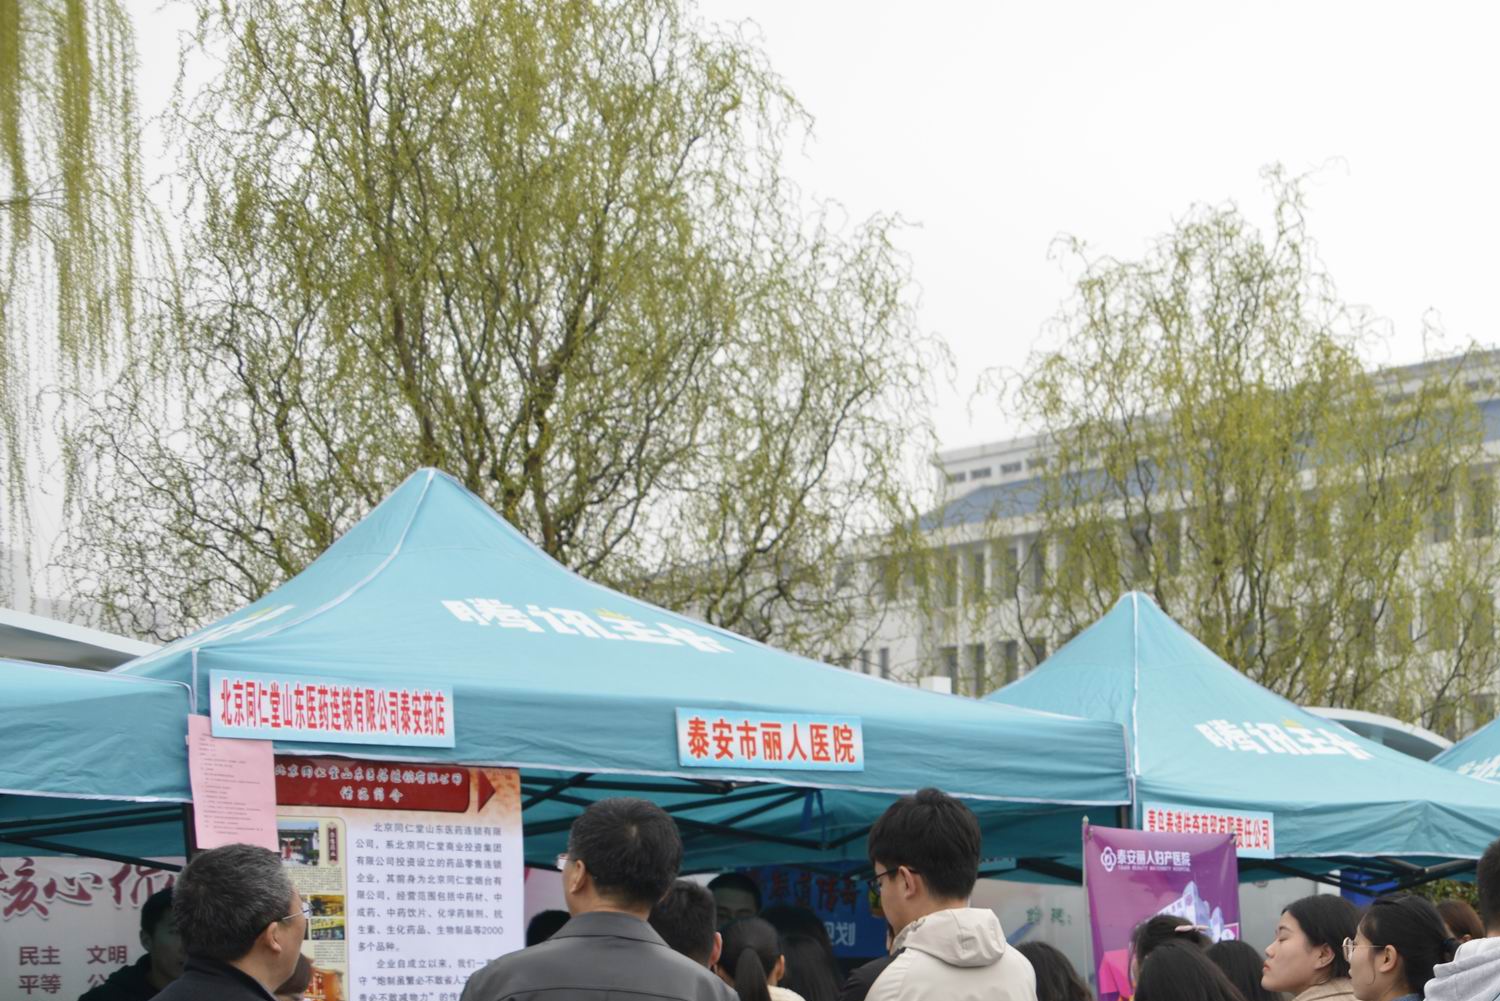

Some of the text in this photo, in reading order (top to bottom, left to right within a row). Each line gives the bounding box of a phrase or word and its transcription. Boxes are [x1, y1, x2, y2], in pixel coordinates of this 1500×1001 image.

[221, 679, 446, 736] 北京同仁堂山东医药连锁有限公司泰安药店
[687, 717, 855, 763] 泰安市丽人医院
[1117, 849, 1192, 867] 泰安丽人妇产医院
[0, 857, 178, 917] 核心价
[19, 946, 127, 966] 民主 文明
[376, 958, 495, 969] 企业自成立以来，我们一
[19, 974, 62, 995] 平等
